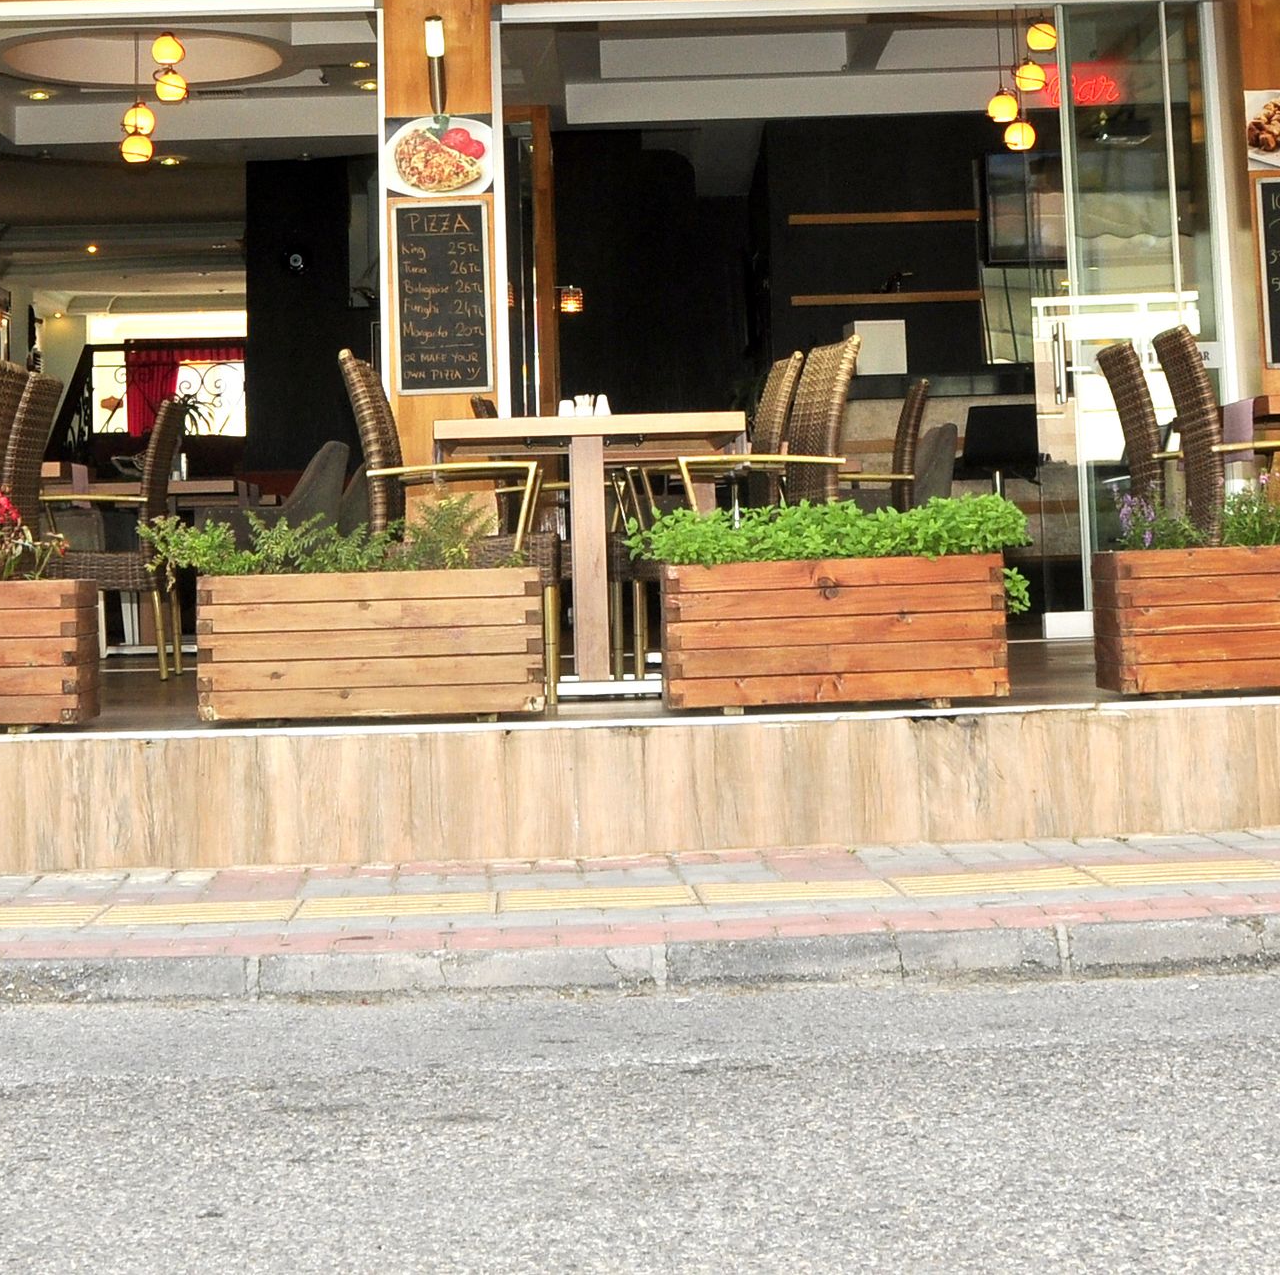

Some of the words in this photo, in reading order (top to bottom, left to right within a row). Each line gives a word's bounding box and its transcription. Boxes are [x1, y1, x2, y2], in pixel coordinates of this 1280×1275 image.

[404, 213, 470, 233] PIZZA
[420, 353, 447, 363] MAKE
[451, 352, 479, 364] YOUR
